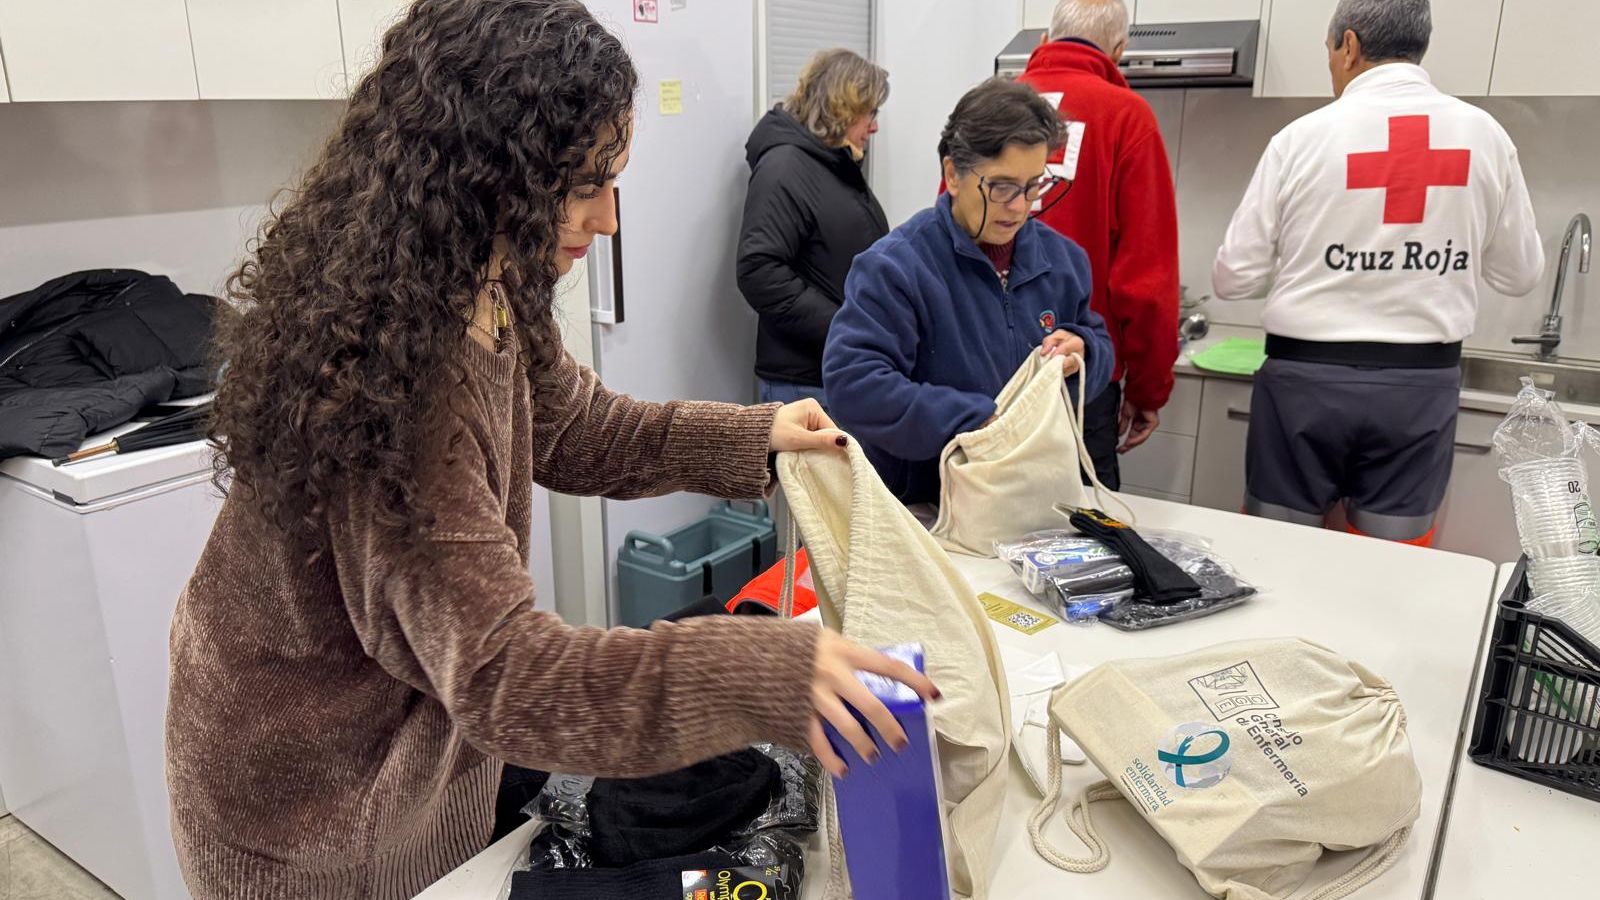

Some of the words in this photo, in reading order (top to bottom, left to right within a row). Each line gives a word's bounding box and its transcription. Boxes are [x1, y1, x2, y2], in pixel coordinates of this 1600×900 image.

[1325, 243, 1394, 271] Cruz
[1402, 239, 1469, 276] Roja
[1568, 481, 1580, 493] 20
[1132, 757, 1174, 807] solidaridad
[1247, 724, 1308, 797] Enfermería
[1125, 765, 1160, 812] enfermera
